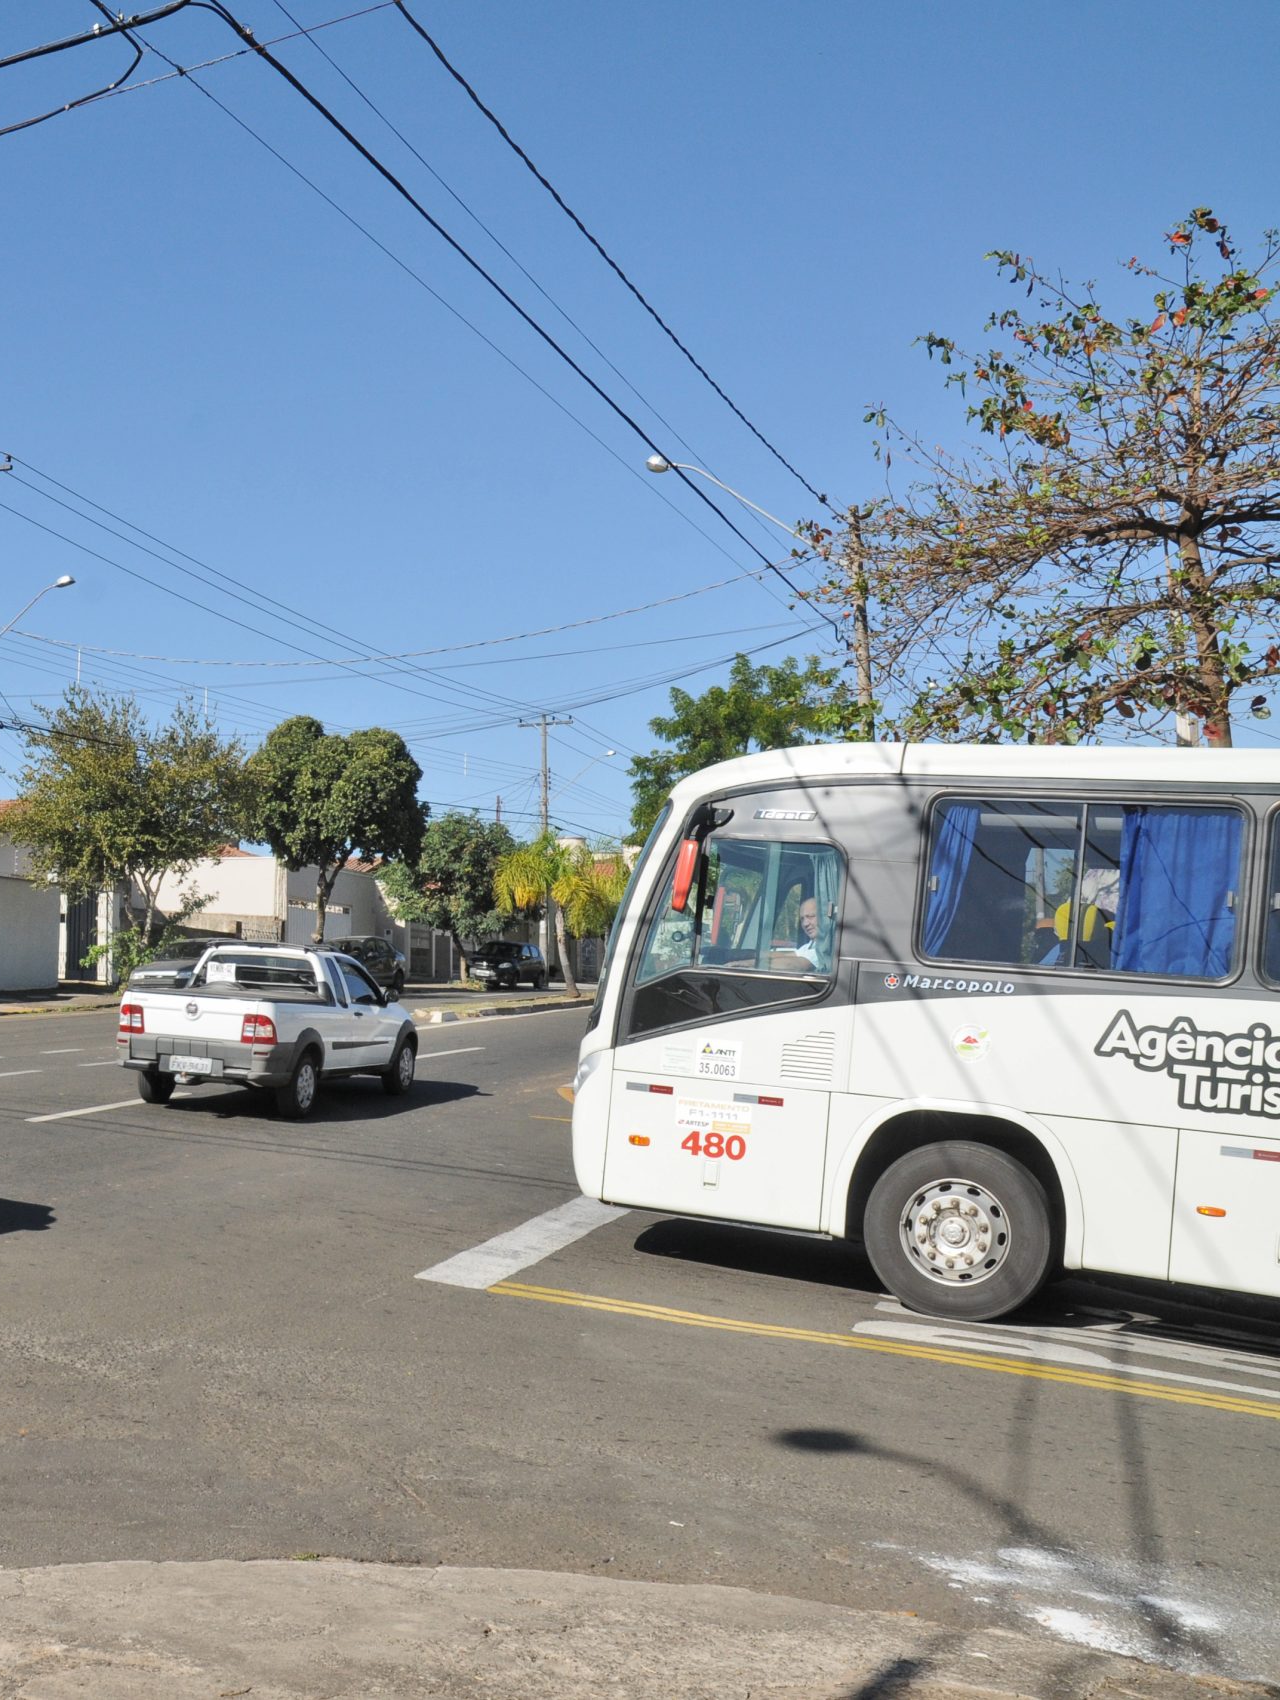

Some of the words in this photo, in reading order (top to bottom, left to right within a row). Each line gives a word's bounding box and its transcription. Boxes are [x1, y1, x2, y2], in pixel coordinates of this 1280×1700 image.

[903, 974, 1015, 994] Marcopolo
[715, 1048, 737, 1057] ANTT
[699, 1062, 736, 1077] 35.0063
[680, 1130, 747, 1161] 480
